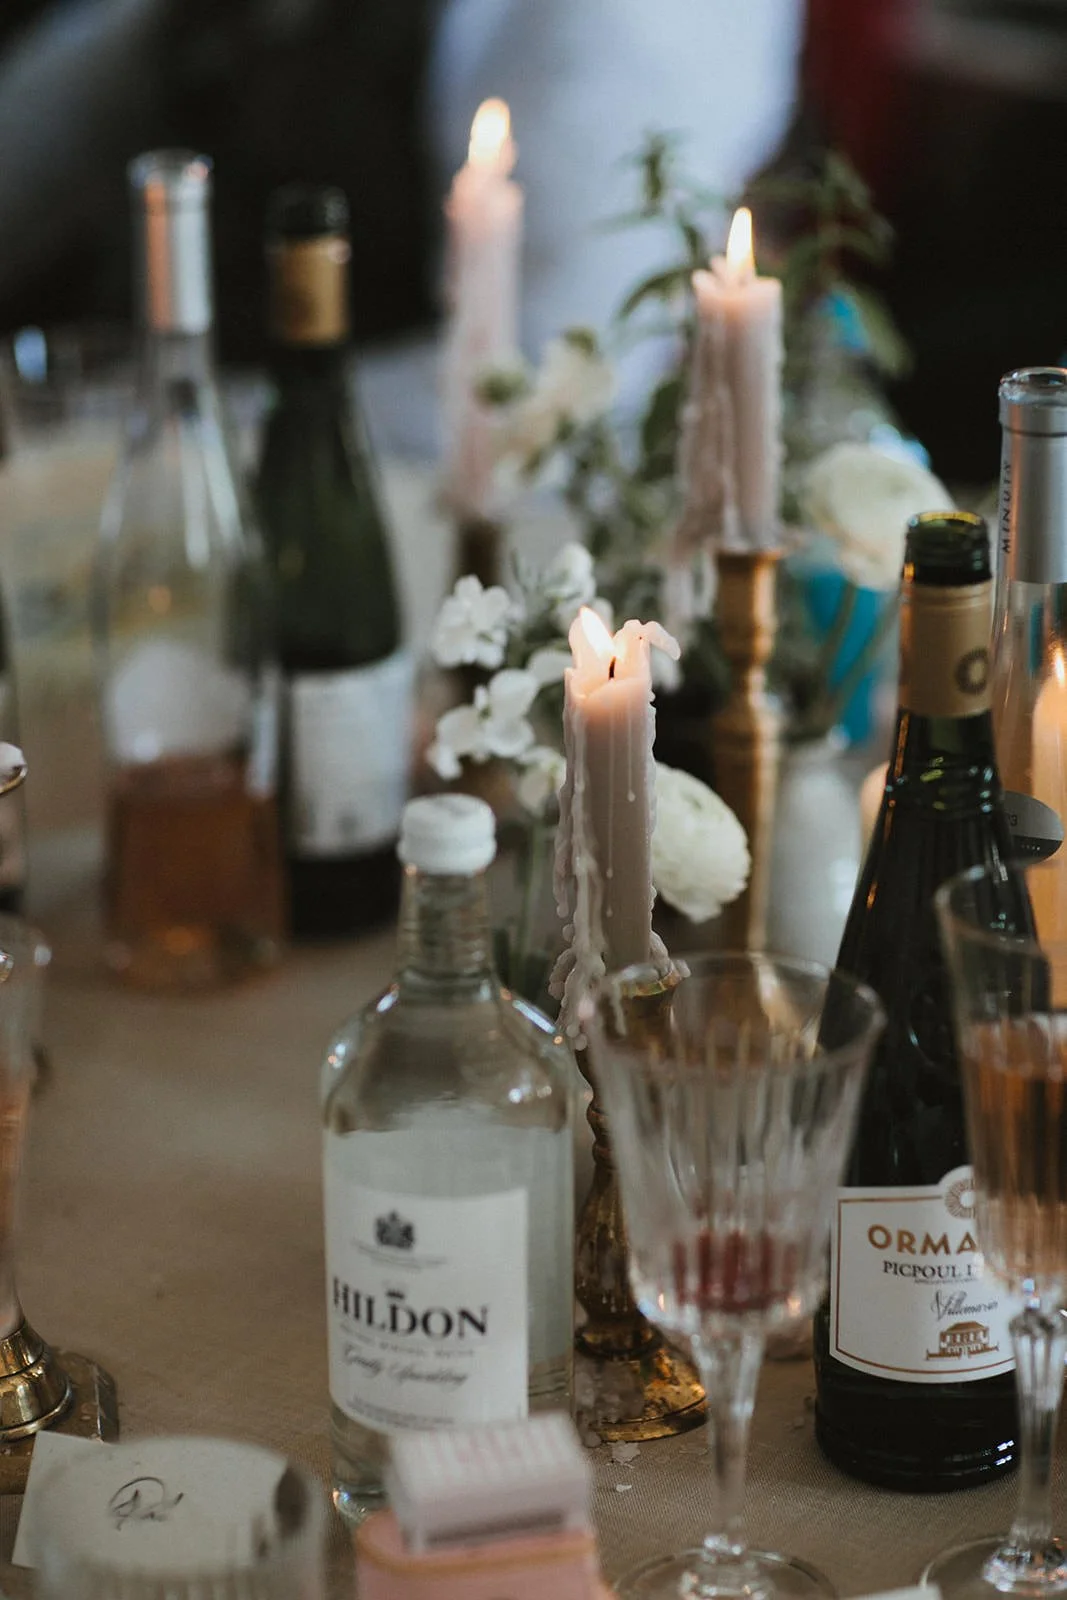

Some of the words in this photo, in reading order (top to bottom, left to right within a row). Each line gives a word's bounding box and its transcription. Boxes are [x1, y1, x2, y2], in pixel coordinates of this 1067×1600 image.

[867, 1224, 977, 1256] ORMA
[883, 1260, 965, 1279] PICPOUL
[333, 1276, 489, 1339] HILDON
